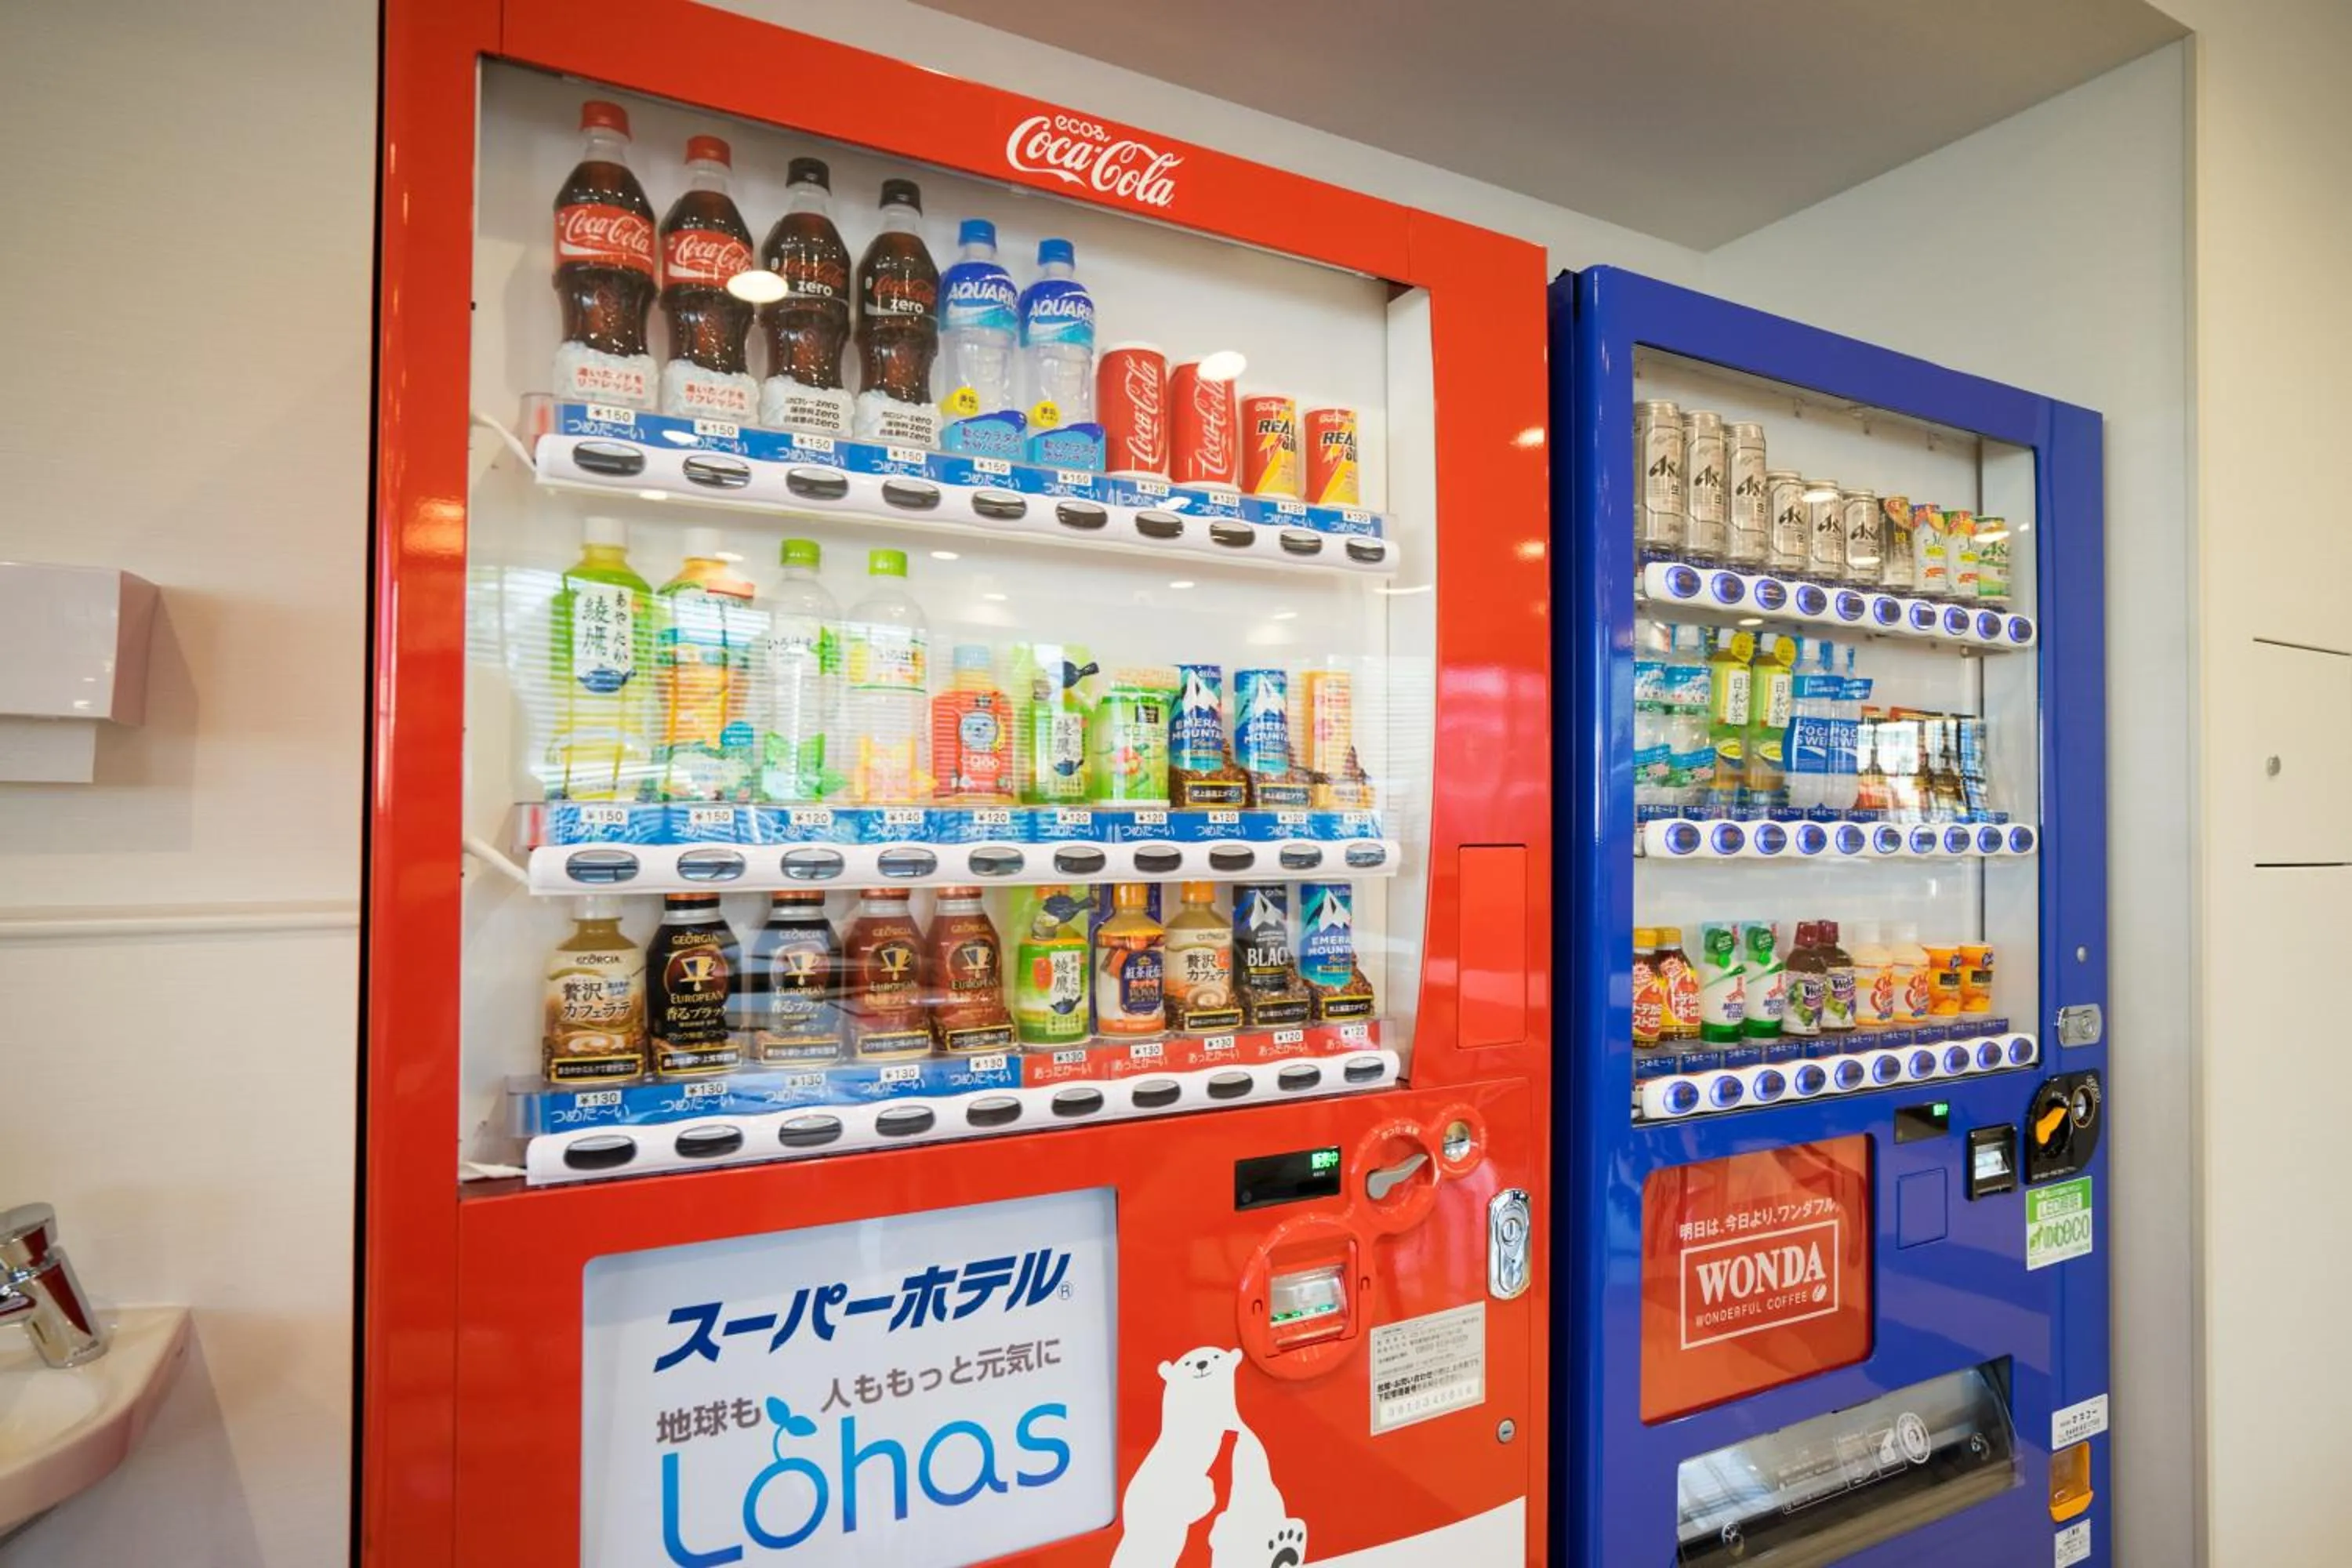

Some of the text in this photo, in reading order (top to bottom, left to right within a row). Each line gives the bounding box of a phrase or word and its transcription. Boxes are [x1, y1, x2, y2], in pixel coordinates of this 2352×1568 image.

[1007, 115, 1185, 207] Coca-Cola
[565, 209, 650, 253] Coca-Cola
[675, 235, 753, 273] Coca-Cola
[797, 281, 833, 297] zero
[890, 297, 924, 314] zero
[593, 407, 631, 423] ¥150
[1127, 355, 1158, 467] Coca-Cola
[700, 422, 735, 437] ¥150
[798, 437, 831, 449] ¥150
[891, 450, 923, 463] ¥150
[978, 461, 1007, 474] ¥150
[1062, 473, 1090, 485] ¥150
[587, 810, 624, 822] ¥150
[695, 811, 730, 822] ¥150
[794, 813, 828, 824] ¥120
[1061, 813, 1089, 823] ¥120
[1138, 813, 1165, 823] ¥120
[1211, 813, 1237, 822] ¥120
[1279, 813, 1305, 822] ¥120
[671, 933, 720, 946] GEORGIA
[779, 927, 822, 940] GEORGIA
[576, 954, 621, 965] GEORGIA
[1247, 946, 1288, 967] BLAC
[775, 985, 826, 996] EUROPEAN
[670, 990, 724, 1005] EUROPEAN
[563, 1000, 630, 1019] カフェラテ
[1276, 1030, 1301, 1041] ¥120
[1206, 1037, 1233, 1048] ¥130
[1134, 1044, 1161, 1056] ¥130
[1055, 1051, 1084, 1063] ¥130
[972, 1058, 1004, 1071] ¥130
[884, 1067, 916, 1080] ¥130
[789, 1074, 823, 1088] ¥130
[687, 1083, 724, 1096] ¥130
[578, 1092, 619, 1105] ¥130
[1696, 1241, 1827, 1306] WONDA
[653, 1247, 1072, 1374] スーパーホテル
[1695, 1290, 1808, 1328] WONDERFUL COFFEE
[656, 1338, 1062, 1445] 地球も 人ももっと元気に
[662, 1396, 1072, 1568] Lohas
